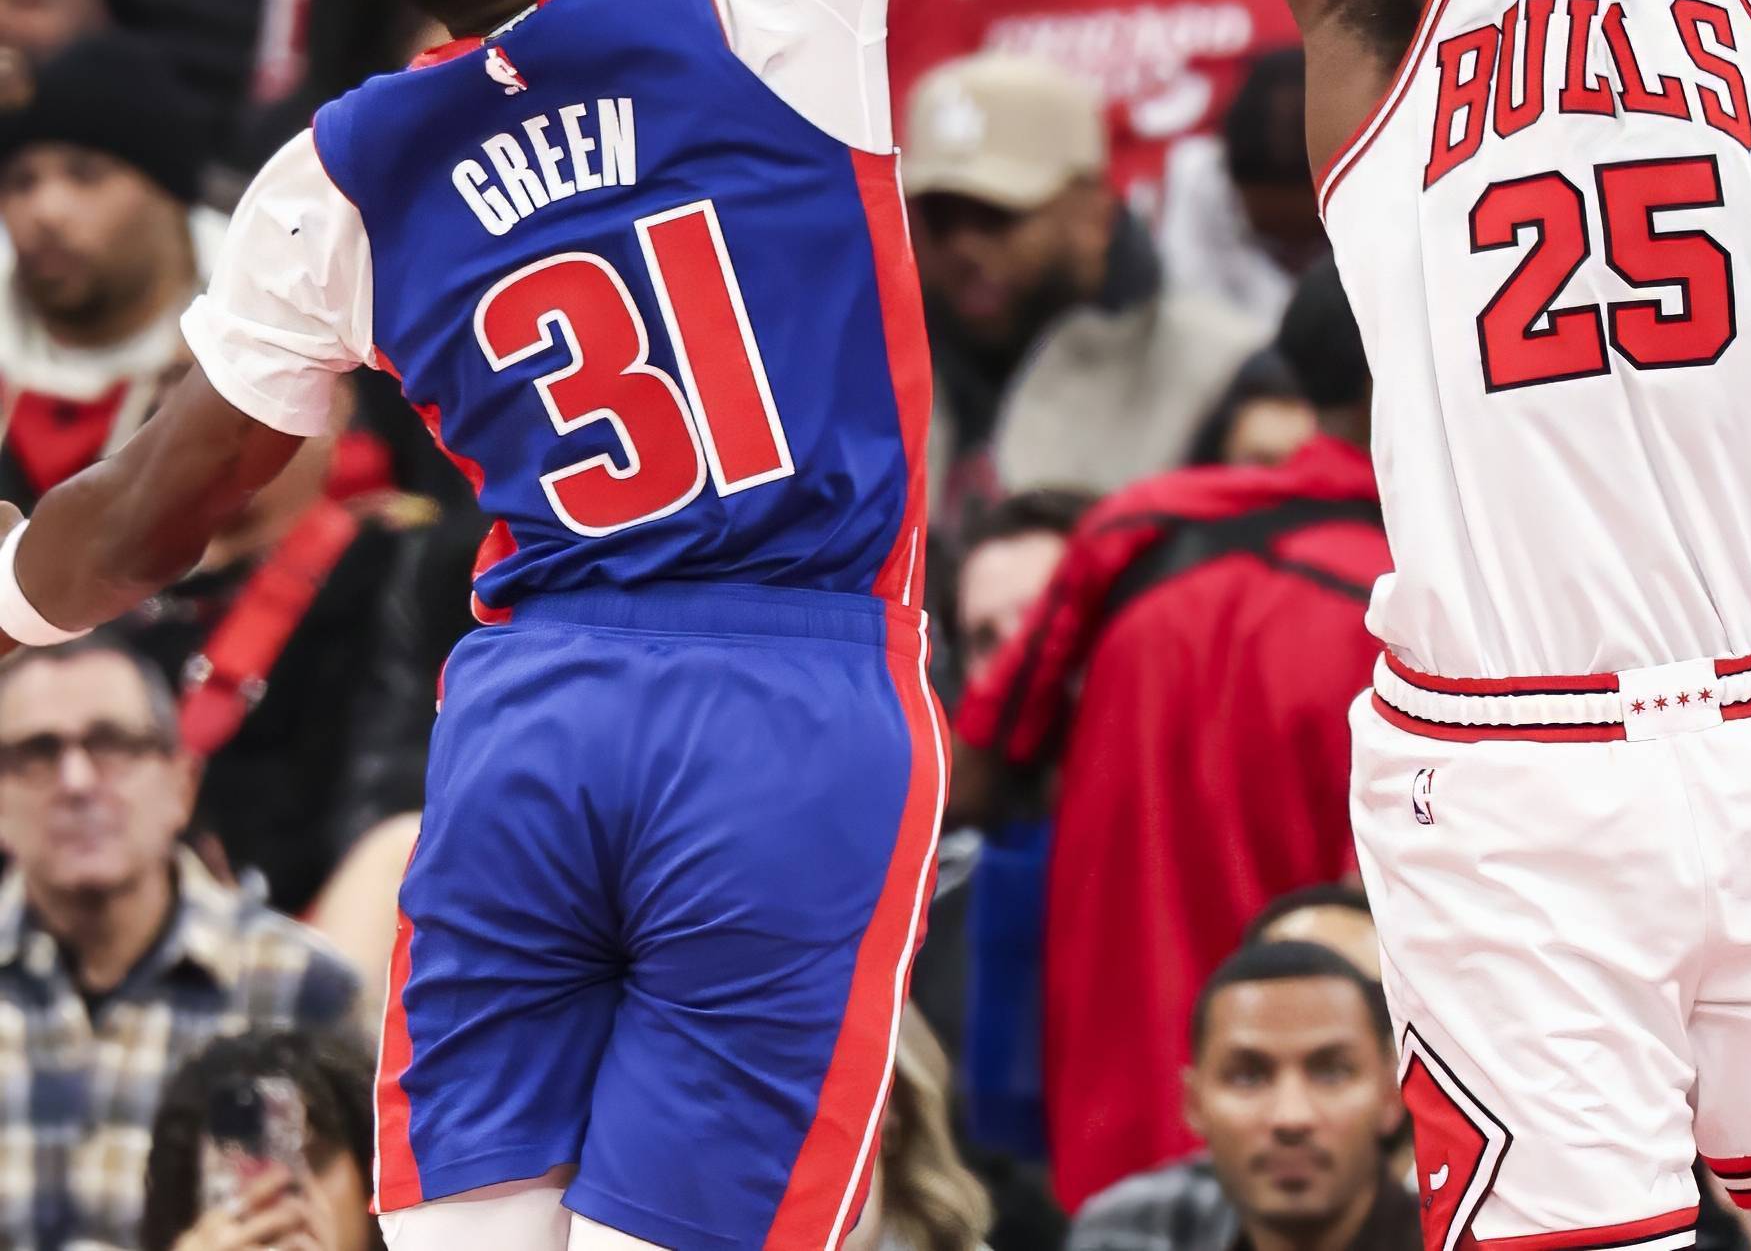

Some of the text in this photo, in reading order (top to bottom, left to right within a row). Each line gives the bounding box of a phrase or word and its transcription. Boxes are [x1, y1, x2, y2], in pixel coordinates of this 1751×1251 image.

[451, 96, 637, 236] GREEN
[1468, 154, 1738, 395] 25
[473, 198, 795, 538] 31
